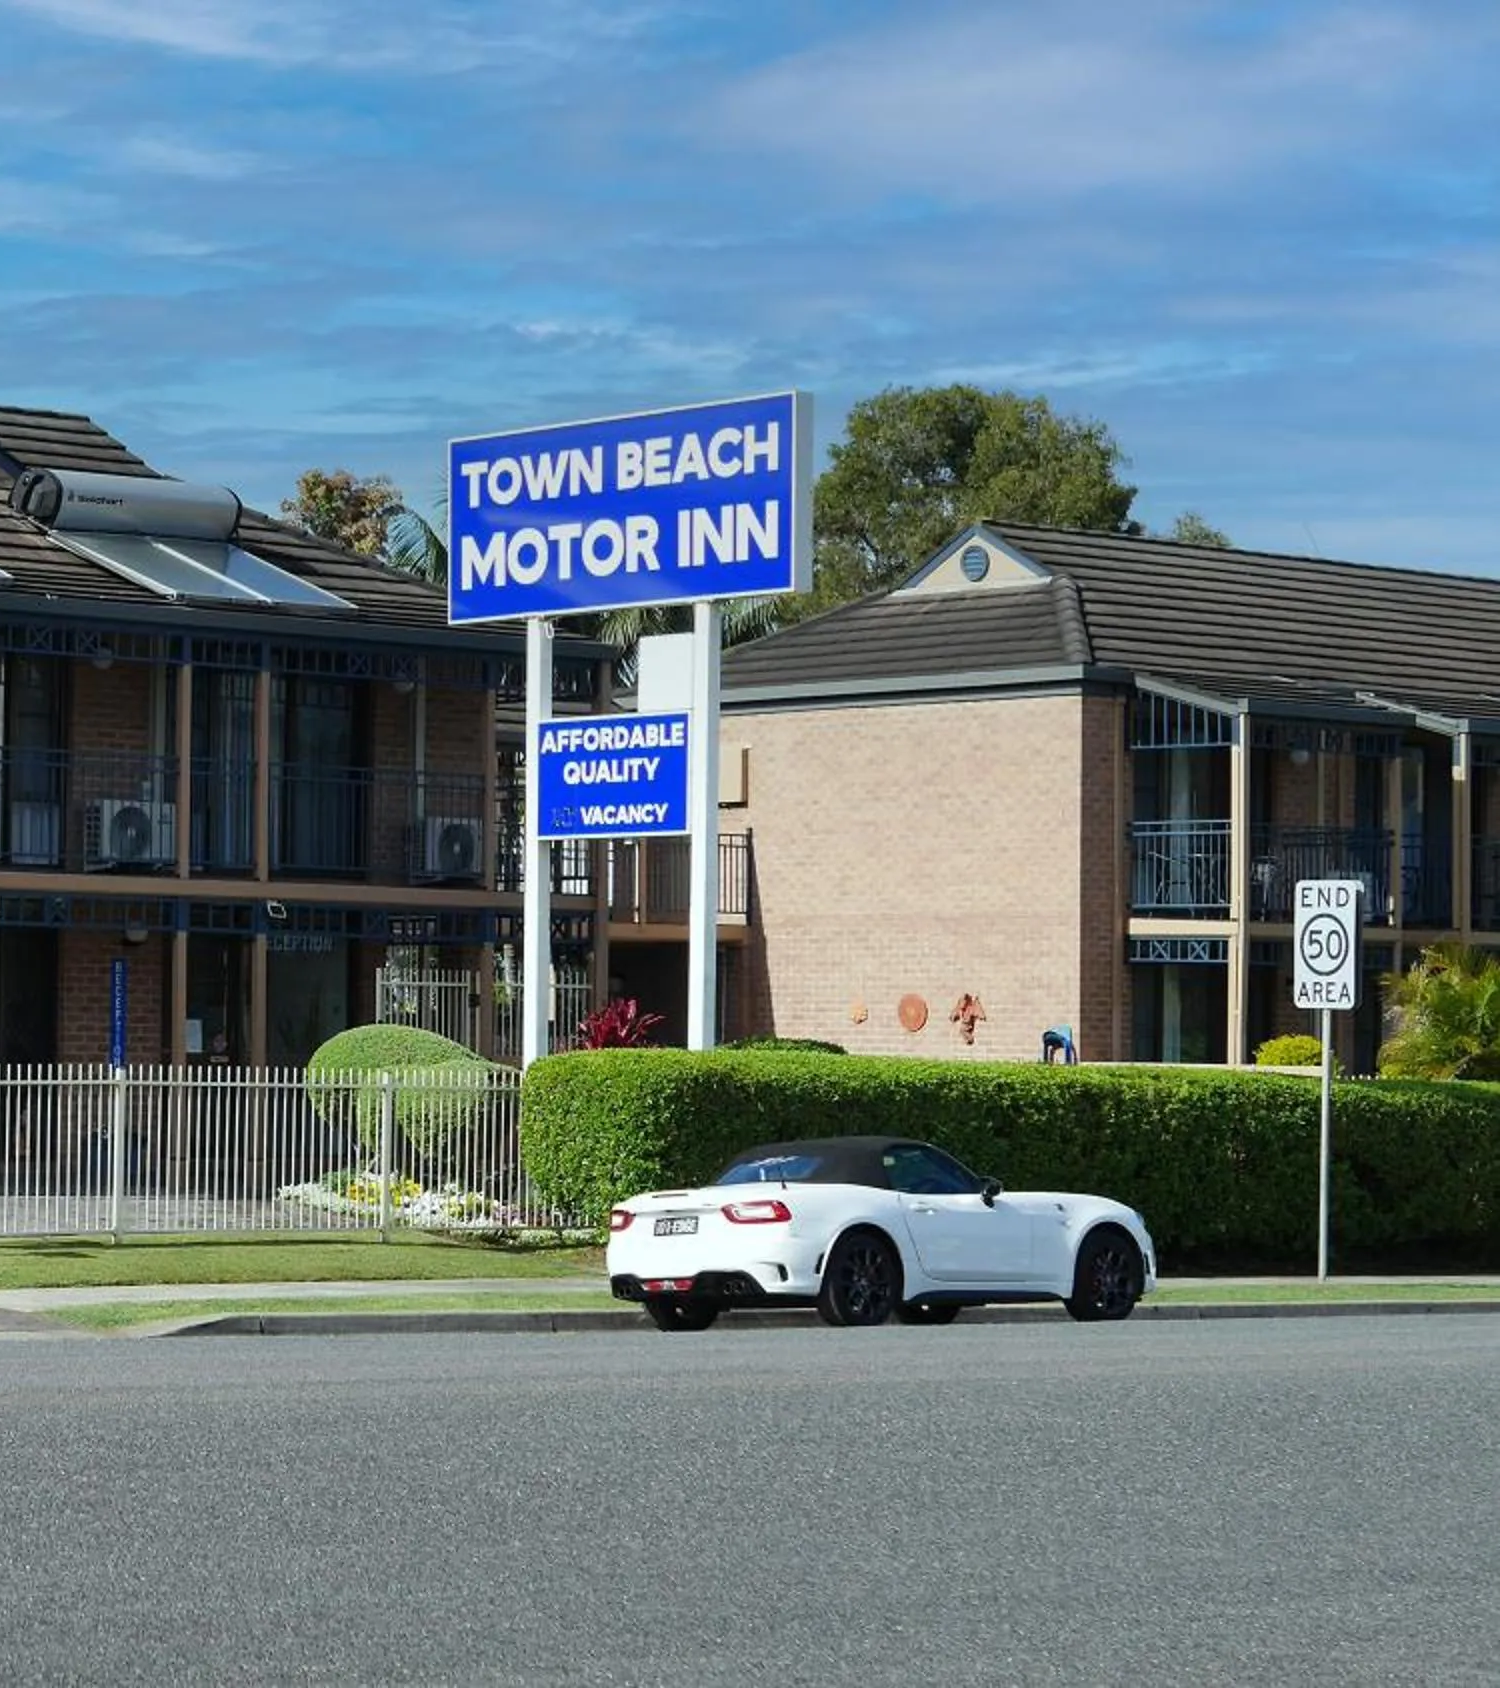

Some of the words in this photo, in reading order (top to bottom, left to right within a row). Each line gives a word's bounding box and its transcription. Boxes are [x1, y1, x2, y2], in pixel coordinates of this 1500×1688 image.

[461, 445, 603, 509] TOWN
[616, 421, 779, 491] BEACH
[461, 514, 661, 591] MOTOR
[677, 499, 779, 568] INN
[541, 721, 685, 755] AFFORDABLE
[563, 757, 661, 786] QUALITY
[580, 802, 669, 826] VACANCY
[1301, 886, 1350, 908] END
[1308, 929, 1343, 960] 50
[1297, 981, 1352, 1003] AREA
